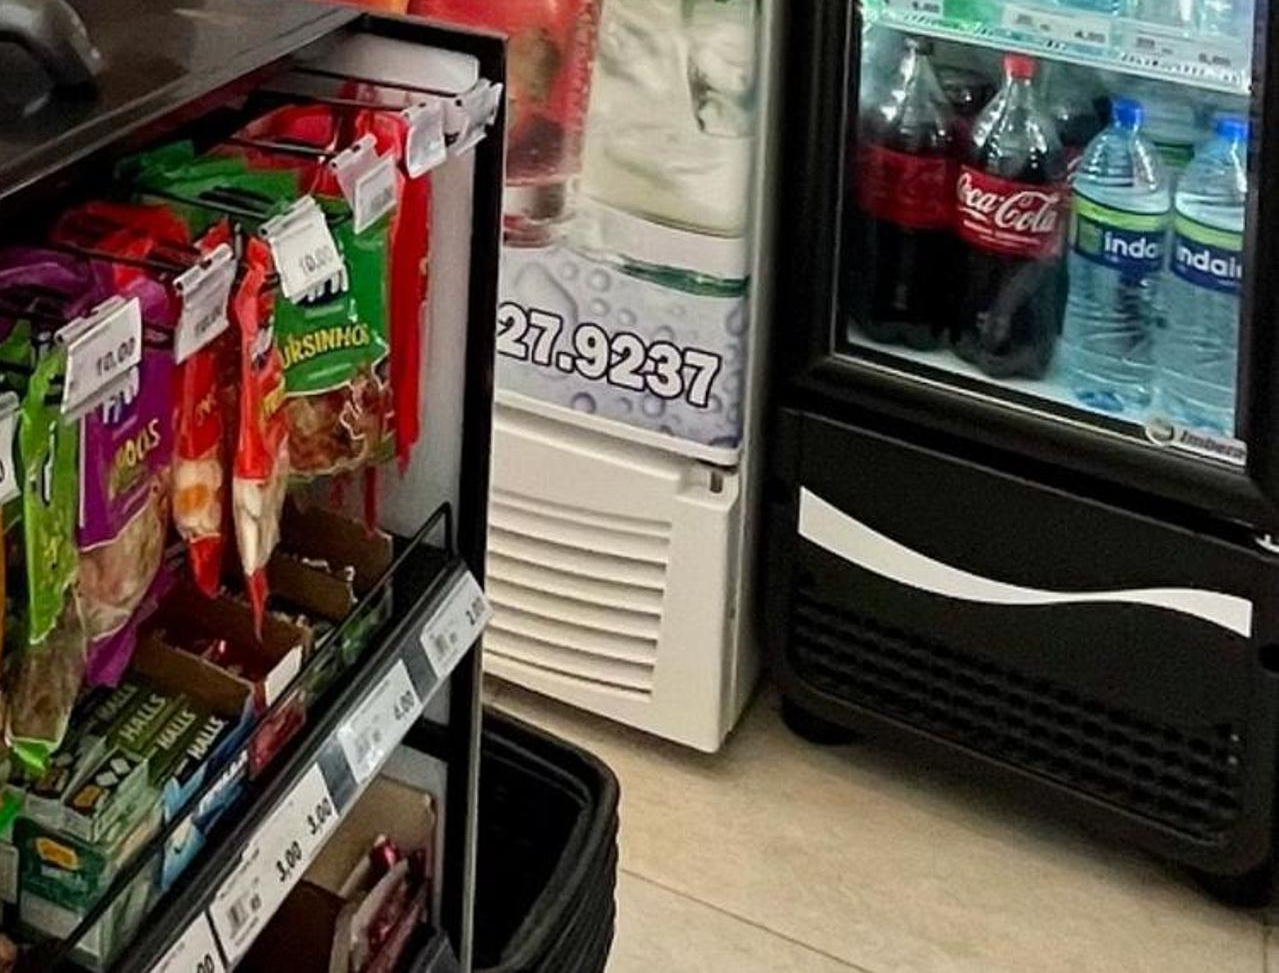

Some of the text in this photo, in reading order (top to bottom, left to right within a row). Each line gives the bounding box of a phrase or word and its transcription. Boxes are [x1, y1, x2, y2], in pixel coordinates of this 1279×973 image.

[118, 692, 167, 743] HALLS
[156, 708, 198, 751] HALLS
[186, 715, 226, 761] HALLS
